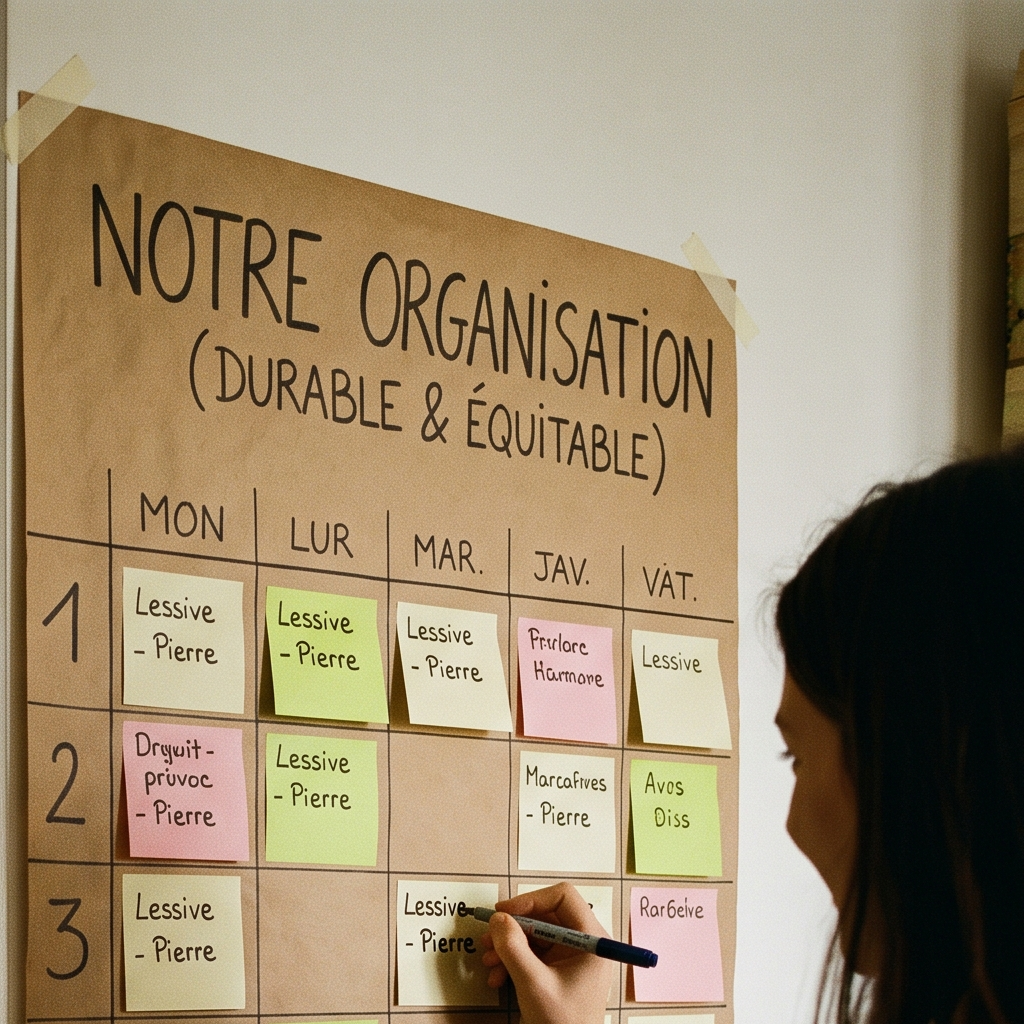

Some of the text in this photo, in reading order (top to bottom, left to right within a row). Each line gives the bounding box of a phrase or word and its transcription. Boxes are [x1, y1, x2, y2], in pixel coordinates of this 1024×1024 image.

[92, 184, 714, 417] NOTRE ORGANISATION
[190, 329, 666, 496] (DURABLE & ÉQUITABLE)
[141, 493, 223, 542] MON
[291, 517, 353, 558] LUR
[415, 534, 483, 574] MAR.
[534, 551, 589, 585] JAV.
[136, 588, 215, 623] Lessive
[279, 602, 353, 634] Lessive
[43, 582, 79, 663] 1
[408, 617, 473, 645] Lessive
[153, 632, 217, 664] Pierre
[296, 641, 359, 670] Pierre
[642, 645, 703, 673] Lessive
[426, 655, 483, 682] Pierre
[277, 744, 350, 773] Lessive
[46, 742, 85, 825] 2
[291, 782, 351, 810] Pierre
[153, 799, 215, 826] Pierre
[541, 801, 590, 827] Pierre
[136, 893, 214, 920] Lessive
[404, 892, 467, 918] Lessive
[47, 899, 88, 980] 3
[153, 936, 216, 962] Pierre
[419, 928, 477, 954] Pierre
